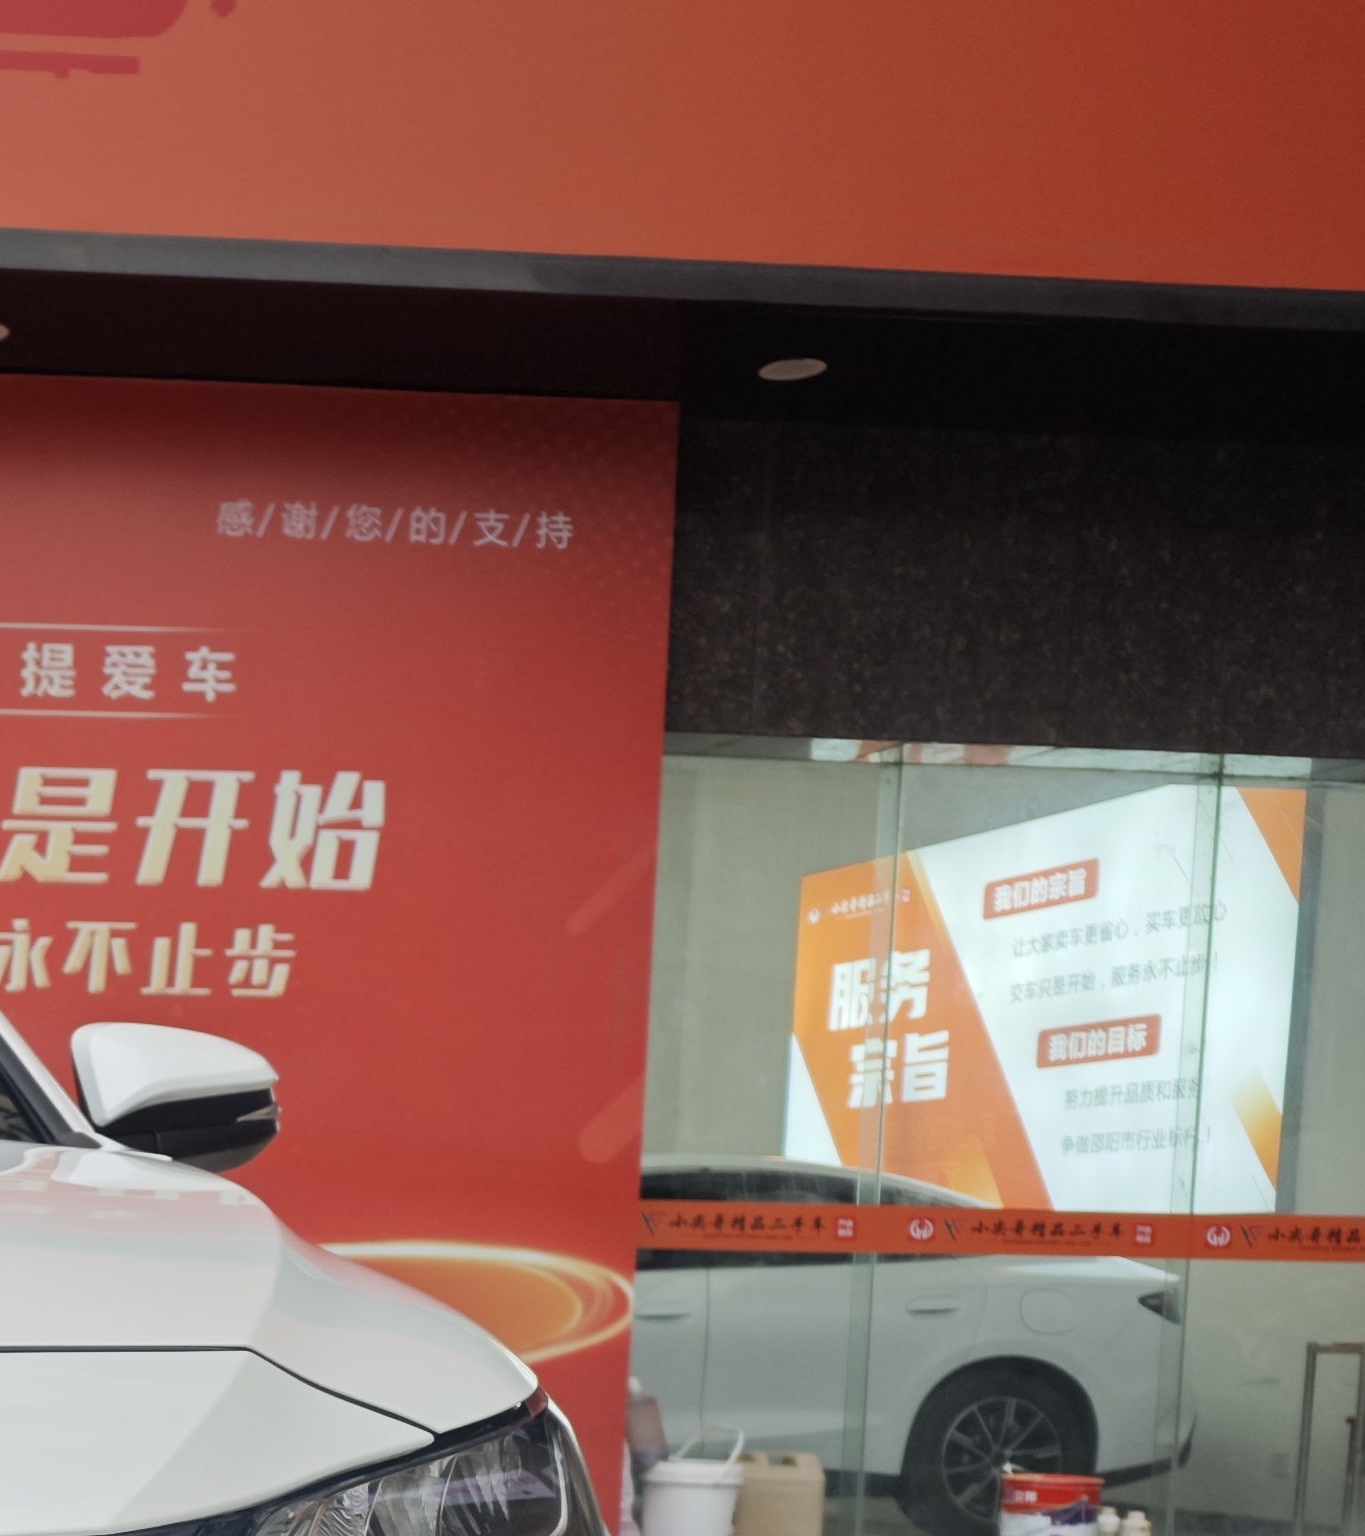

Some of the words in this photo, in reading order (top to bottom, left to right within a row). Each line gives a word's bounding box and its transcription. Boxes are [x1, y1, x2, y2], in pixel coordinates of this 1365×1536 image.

[215, 499, 574, 550] 感/谢/您/的/支/持
[993, 867, 1087, 913] 我们的宗旨
[827, 948, 931, 1032] 服务
[1047, 1022, 1148, 1062] 我们的目标
[847, 1029, 951, 1109] 宗旨
